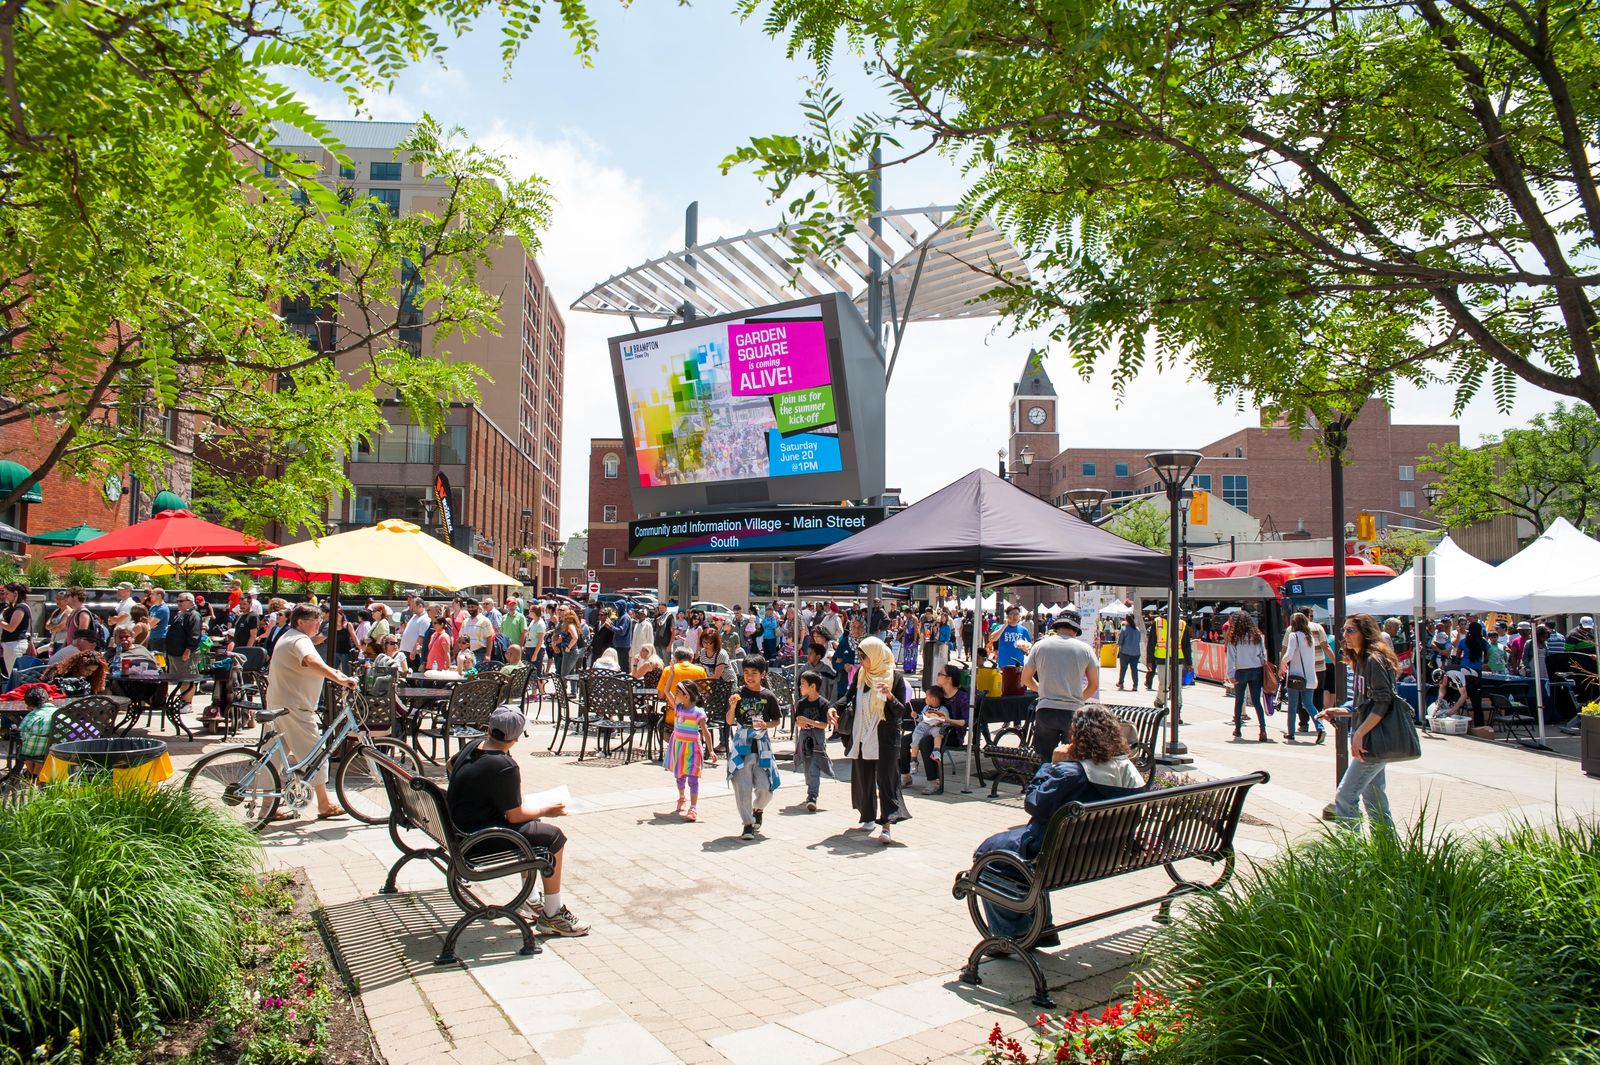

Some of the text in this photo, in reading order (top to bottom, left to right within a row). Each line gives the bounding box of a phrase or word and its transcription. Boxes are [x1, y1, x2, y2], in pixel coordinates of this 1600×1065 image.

[735, 326, 787, 347] GARDEN
[633, 341, 659, 353] BRAMPTON
[737, 341, 789, 362] SQUARE
[748, 358, 781, 370] is coming
[740, 366, 793, 391] ALIVE!
[780, 391, 822, 406] Join us for
[779, 402, 826, 416] the summer
[789, 412, 820, 425] kick-off
[780, 441, 818, 452] Saturday
[780, 450, 814, 462] June 20
[634, 522, 671, 537] Community
[672, 522, 687, 534] and
[689, 519, 742, 533] Information
[744, 516, 782, 532] Village
[793, 516, 823, 529] Main
[826, 515, 866, 528] Street
[710, 536, 739, 548] South
